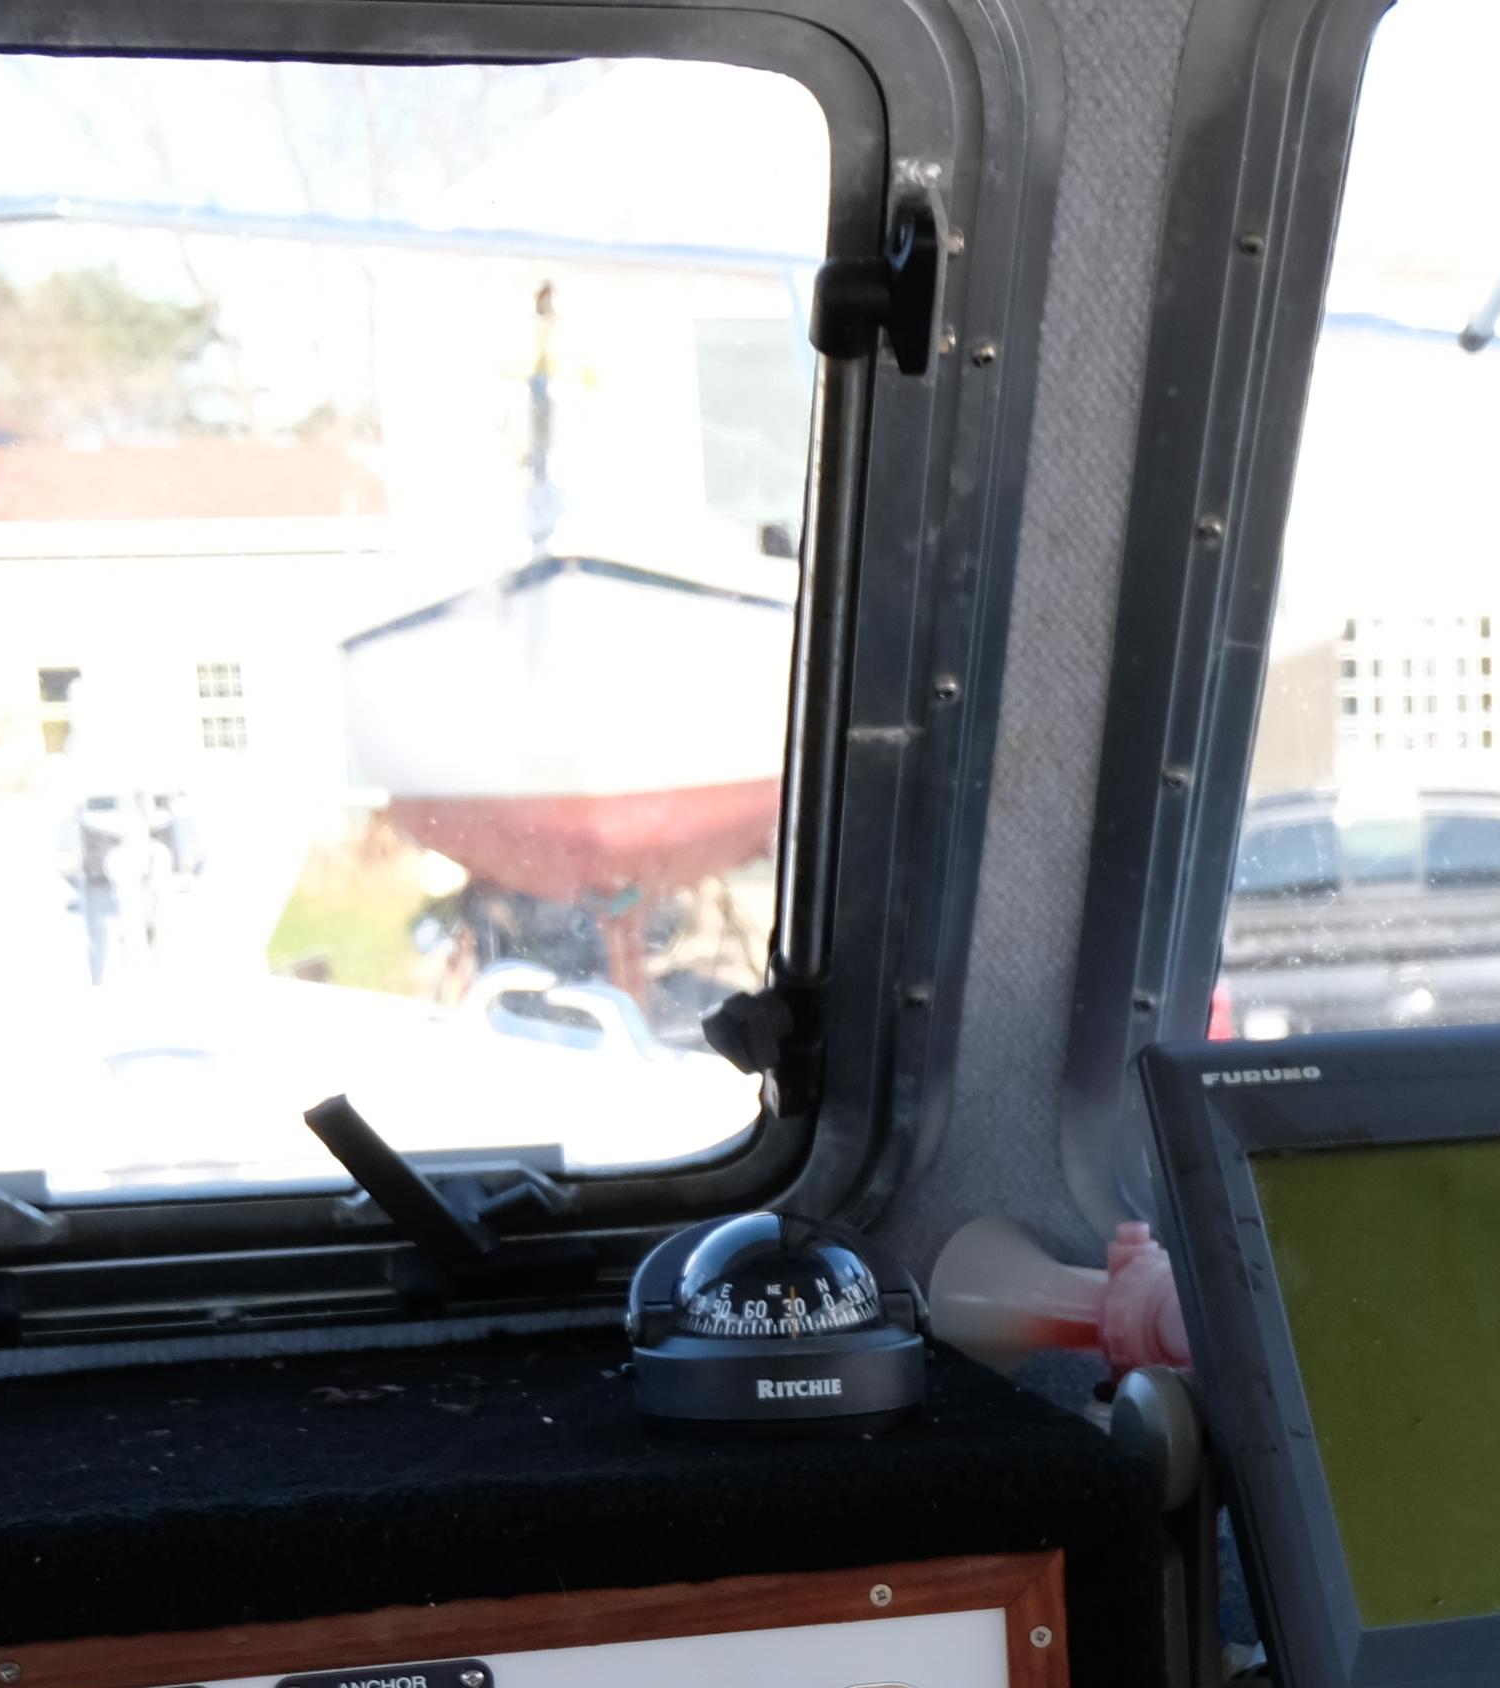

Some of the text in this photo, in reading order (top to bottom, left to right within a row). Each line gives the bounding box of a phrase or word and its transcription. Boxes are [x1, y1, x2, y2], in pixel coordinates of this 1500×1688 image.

[1202, 1066, 1320, 1085] FURUNO
[721, 1284, 732, 1298] E
[767, 1284, 782, 1296] NE
[815, 1277, 830, 1293] N
[713, 1299, 731, 1318] 90
[744, 1300, 768, 1319] 60
[782, 1297, 807, 1317] 30
[823, 1293, 835, 1311] 0
[757, 1378, 842, 1399] RITCHIE
